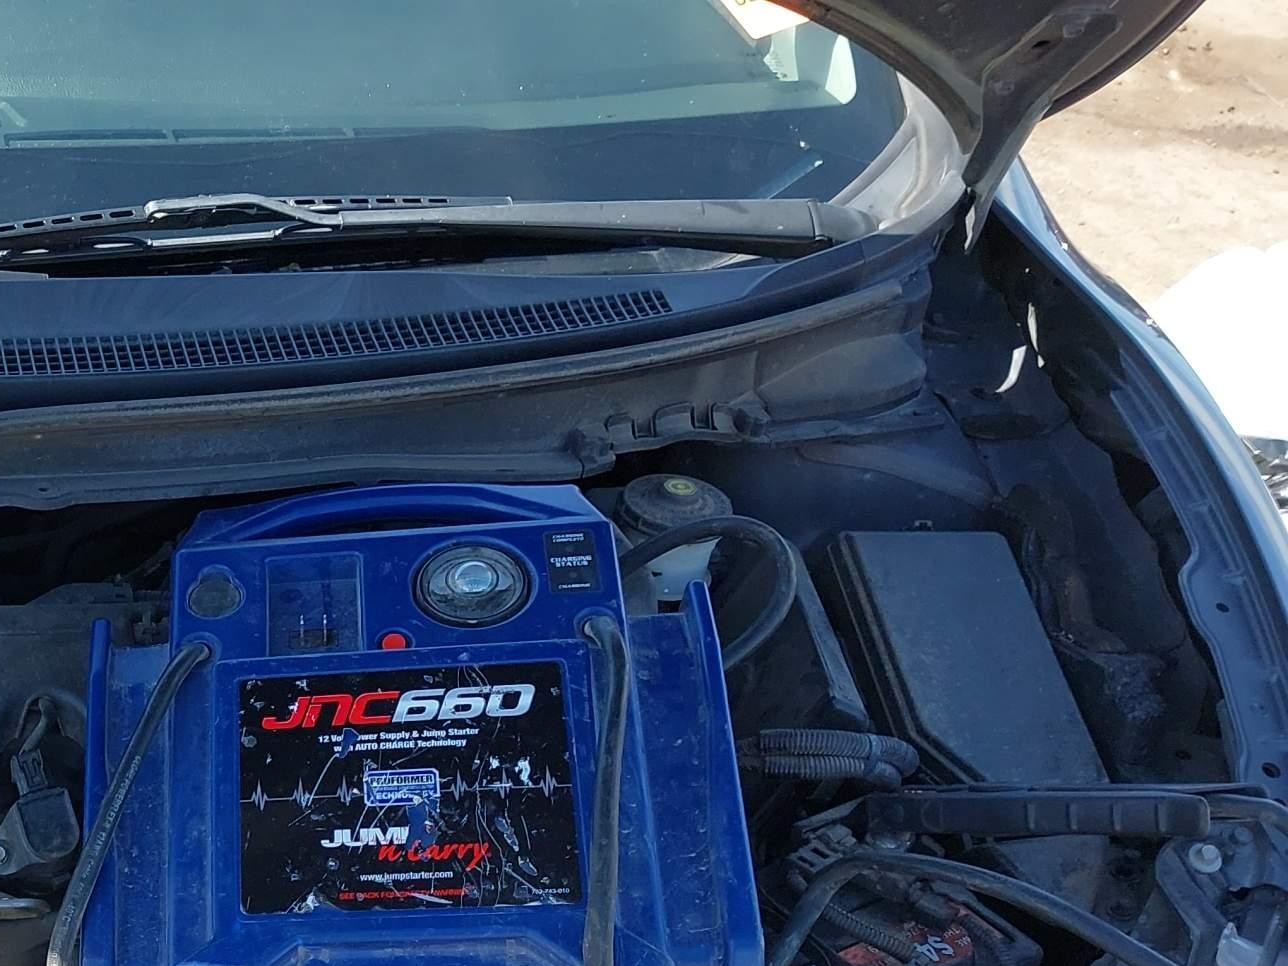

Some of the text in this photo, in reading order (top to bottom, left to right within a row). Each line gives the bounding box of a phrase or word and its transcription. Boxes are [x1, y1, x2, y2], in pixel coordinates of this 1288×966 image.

[550, 555, 592, 563] CHARGING
[555, 560, 589, 568] STATUS
[318, 735, 330, 743] 12
[380, 731, 410, 741] Supply
[412, 730, 419, 738] &
[421, 729, 446, 740] Jump
[448, 727, 480, 736] Starter
[355, 742, 378, 751] AUTO
[380, 741, 415, 750] CHARGE
[417, 738, 467, 749] Technology
[360, 870, 454, 883] www.jumpstarter.com
